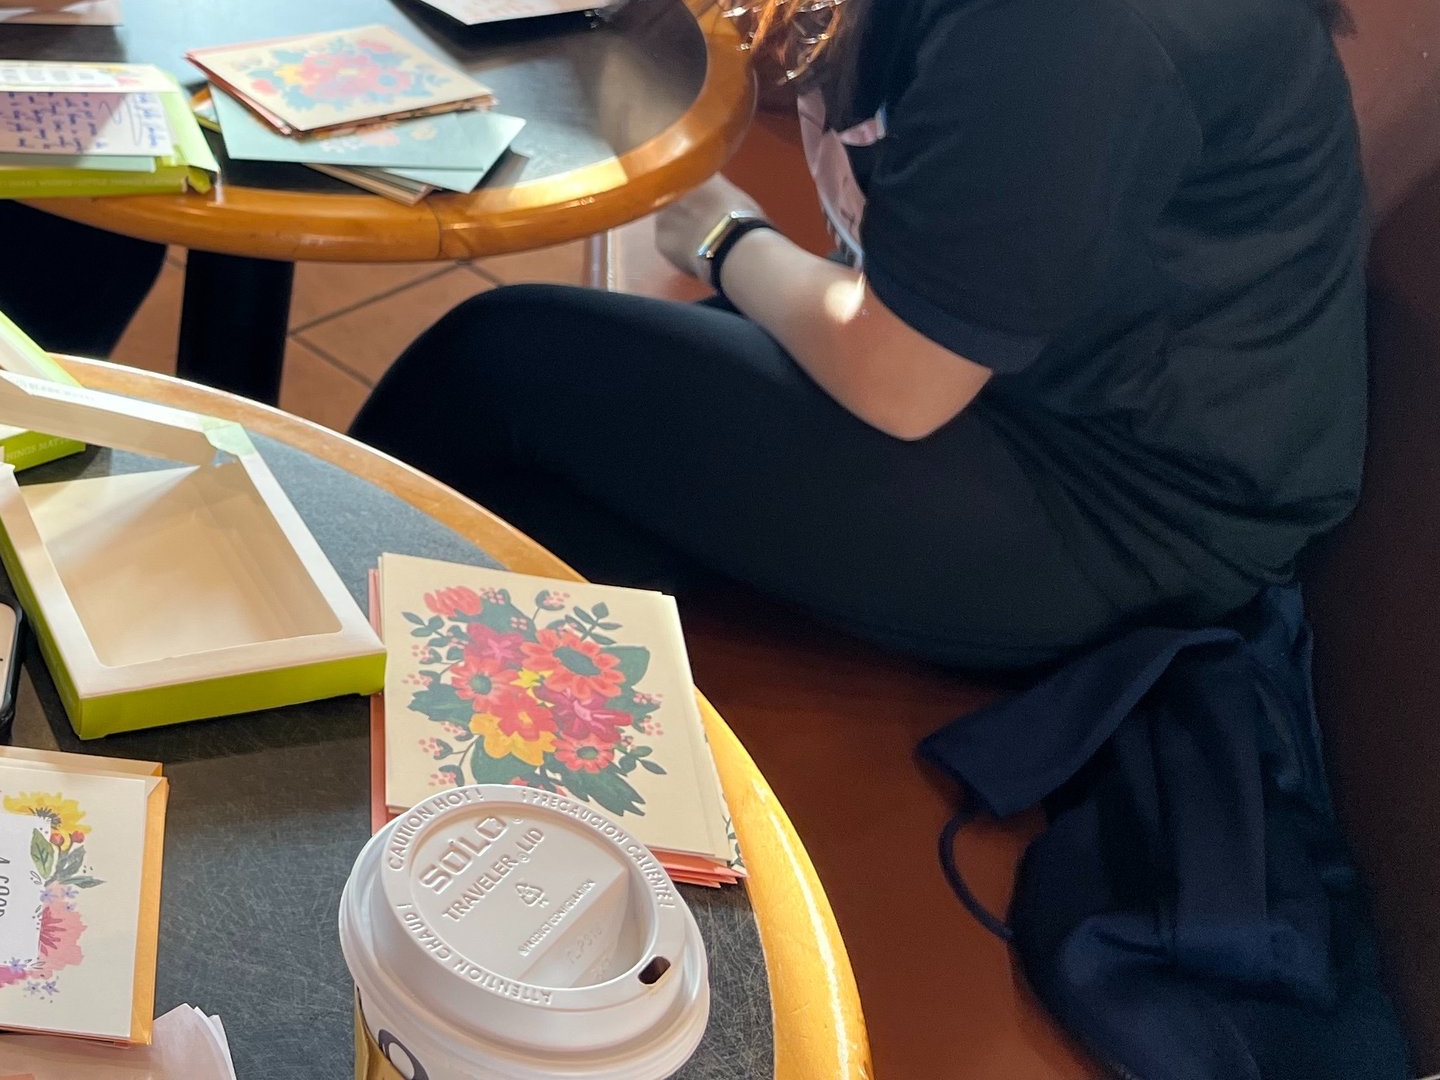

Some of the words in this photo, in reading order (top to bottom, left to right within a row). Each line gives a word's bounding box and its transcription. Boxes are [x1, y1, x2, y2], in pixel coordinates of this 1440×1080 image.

[388, 805, 434, 871] CAUTION
[418, 815, 510, 895] SOLO
[442, 853, 520, 922] TRAVELER
[515, 827, 545, 855] LID
[453, 958, 554, 1006] ATTENTION
